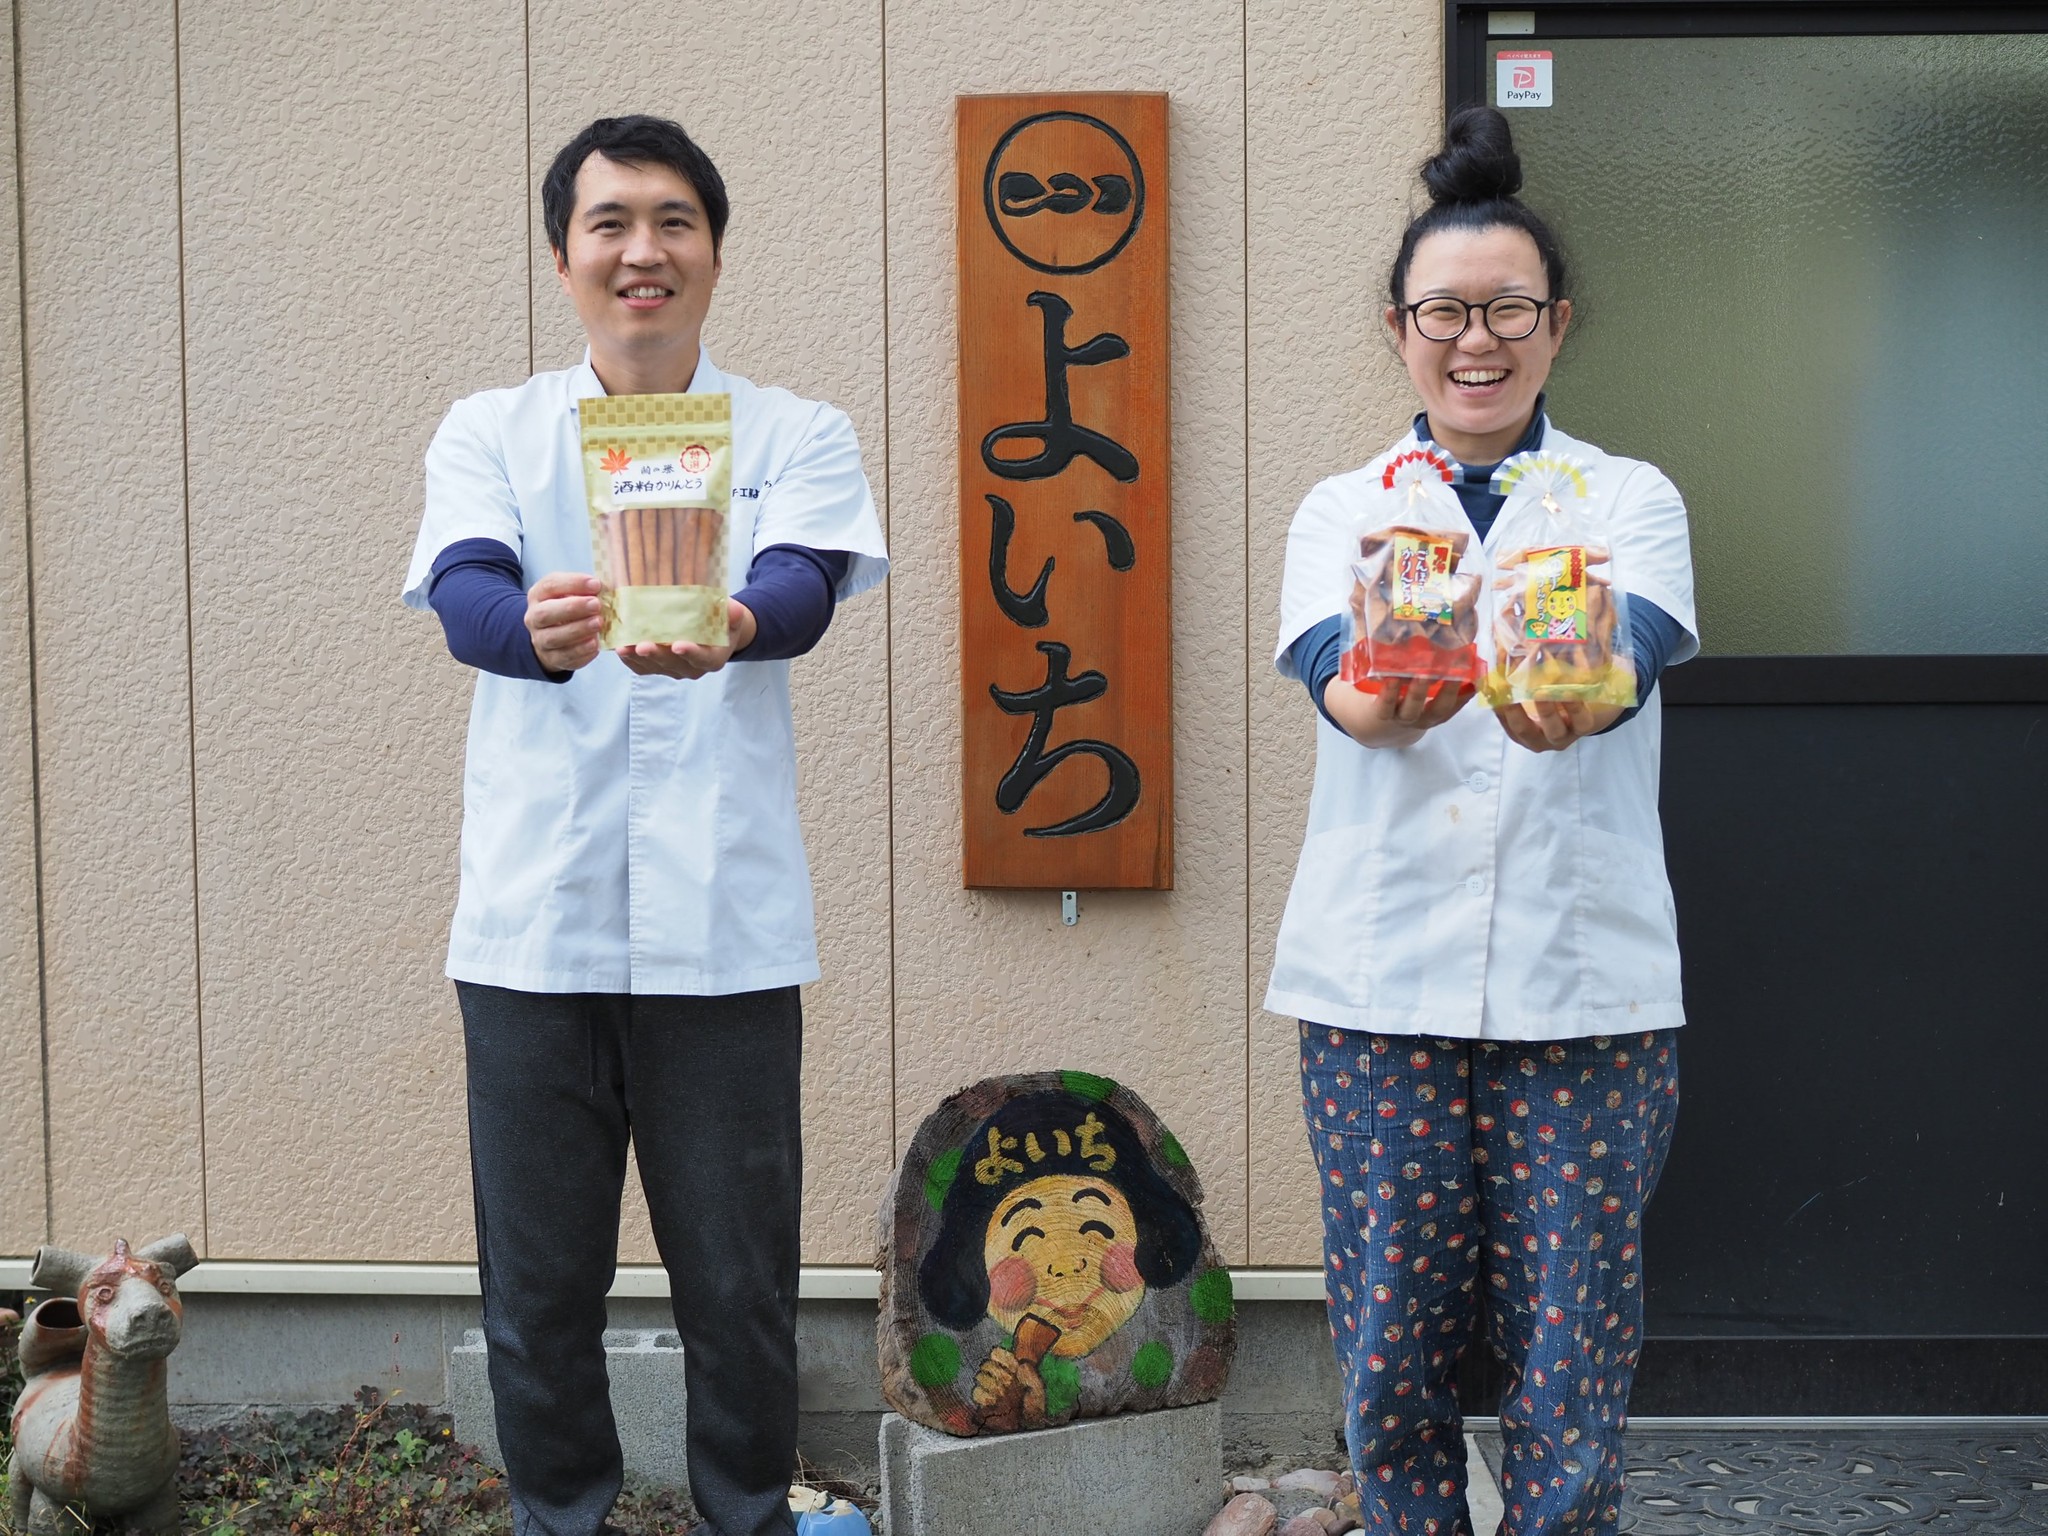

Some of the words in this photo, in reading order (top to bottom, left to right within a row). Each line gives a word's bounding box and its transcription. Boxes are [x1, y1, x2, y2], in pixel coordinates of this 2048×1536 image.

[1507, 90, 1541, 100] PayPay
[613, 478, 703, 495] 酒粕かりんとう
[981, 290, 1141, 838] よいち
[974, 1112, 1117, 1186] よいち
